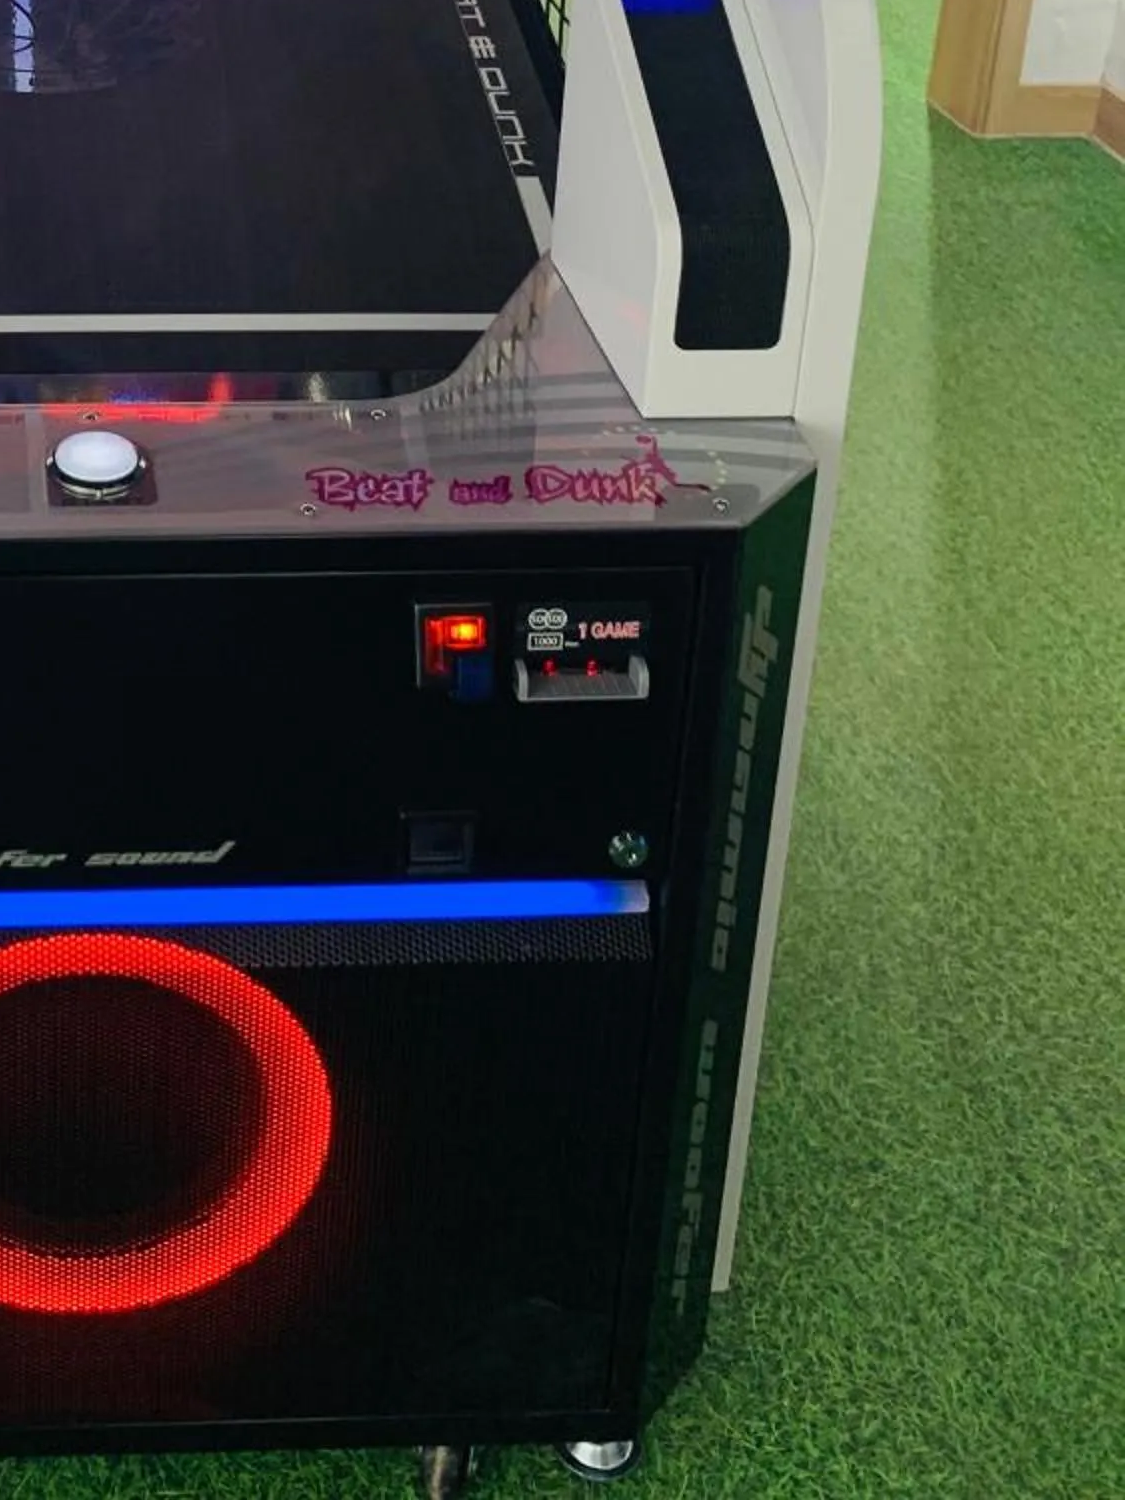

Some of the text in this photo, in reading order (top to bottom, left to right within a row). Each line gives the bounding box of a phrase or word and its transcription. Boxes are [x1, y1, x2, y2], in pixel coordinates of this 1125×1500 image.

[479, 67, 535, 167] DUNK
[306, 462, 662, 511] Beat and Dunk
[578, 622, 641, 640] 1 GAME
[85, 840, 236, 867] sound
